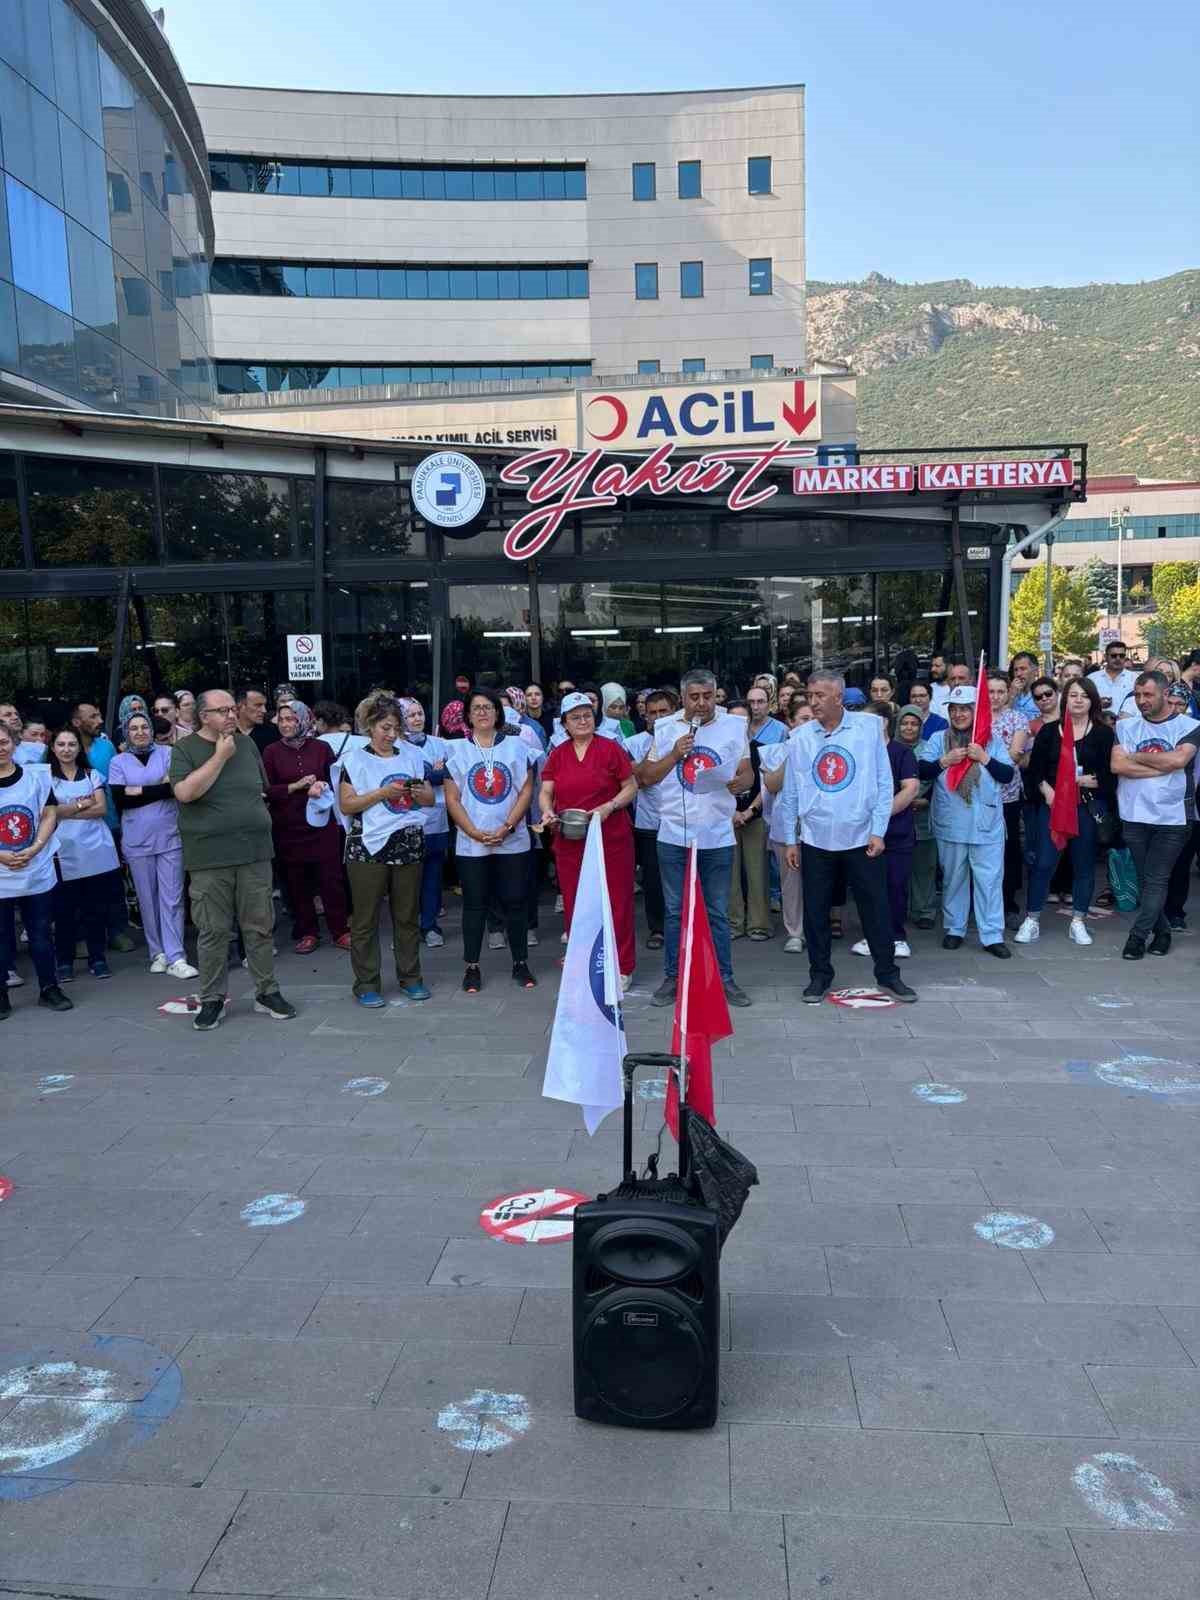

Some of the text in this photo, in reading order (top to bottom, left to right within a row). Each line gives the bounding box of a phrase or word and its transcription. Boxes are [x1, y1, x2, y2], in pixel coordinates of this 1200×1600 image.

[474, 428, 503, 444] ACİL
[507, 424, 557, 443] SERVİSİ
[416, 457, 443, 500] PAMUKKALE
[797, 466, 911, 492] MARKET
[924, 461, 1068, 488] KAFETERYA
